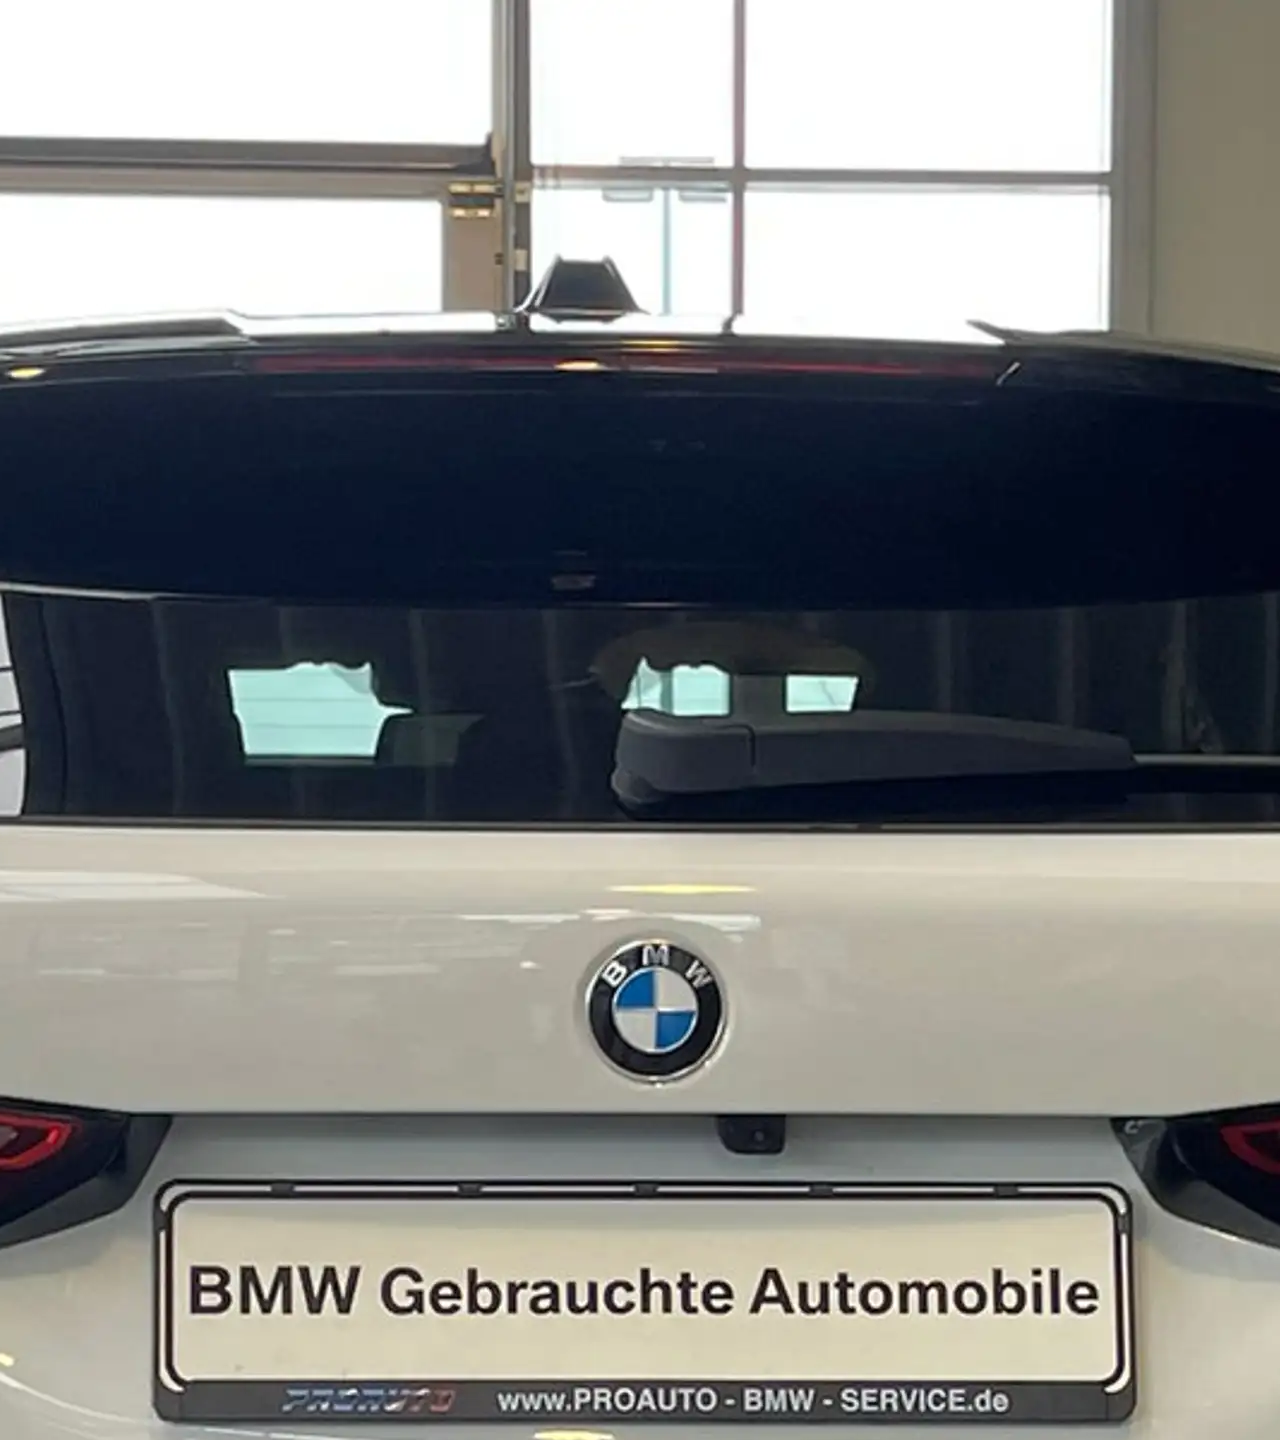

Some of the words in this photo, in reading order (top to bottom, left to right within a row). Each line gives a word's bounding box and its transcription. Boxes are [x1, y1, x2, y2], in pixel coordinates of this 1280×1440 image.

[601, 943, 715, 989] BMW
[189, 1265, 361, 1315] BMW
[380, 1266, 735, 1315] Gebrauchte
[749, 1267, 1100, 1315] Automobile
[498, 1387, 718, 1413] www.PROAUTO
[743, 1387, 816, 1413] BMW
[840, 1387, 1010, 1413] SERVICE.de
